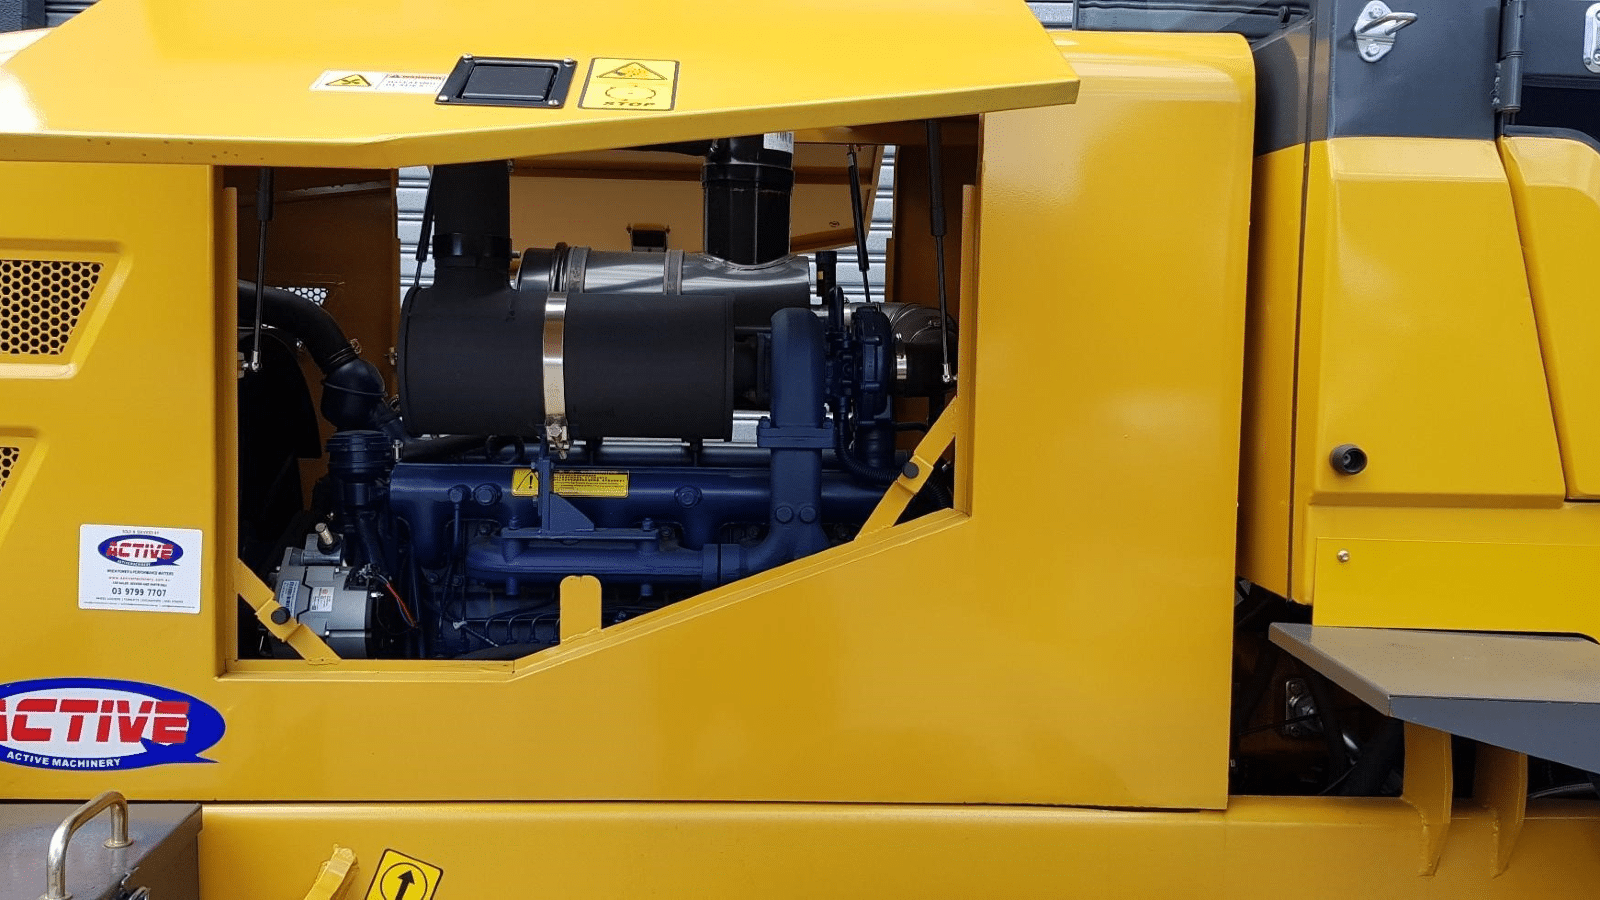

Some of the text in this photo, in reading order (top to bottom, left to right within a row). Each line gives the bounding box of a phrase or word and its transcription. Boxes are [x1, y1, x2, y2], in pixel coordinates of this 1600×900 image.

[106, 540, 175, 560] ACTIVE
[112, 587, 167, 597] 03 9799 7707
[0, 698, 190, 744] CTIVE
[6, 751, 121, 768] ACTIVE MACHINERY
